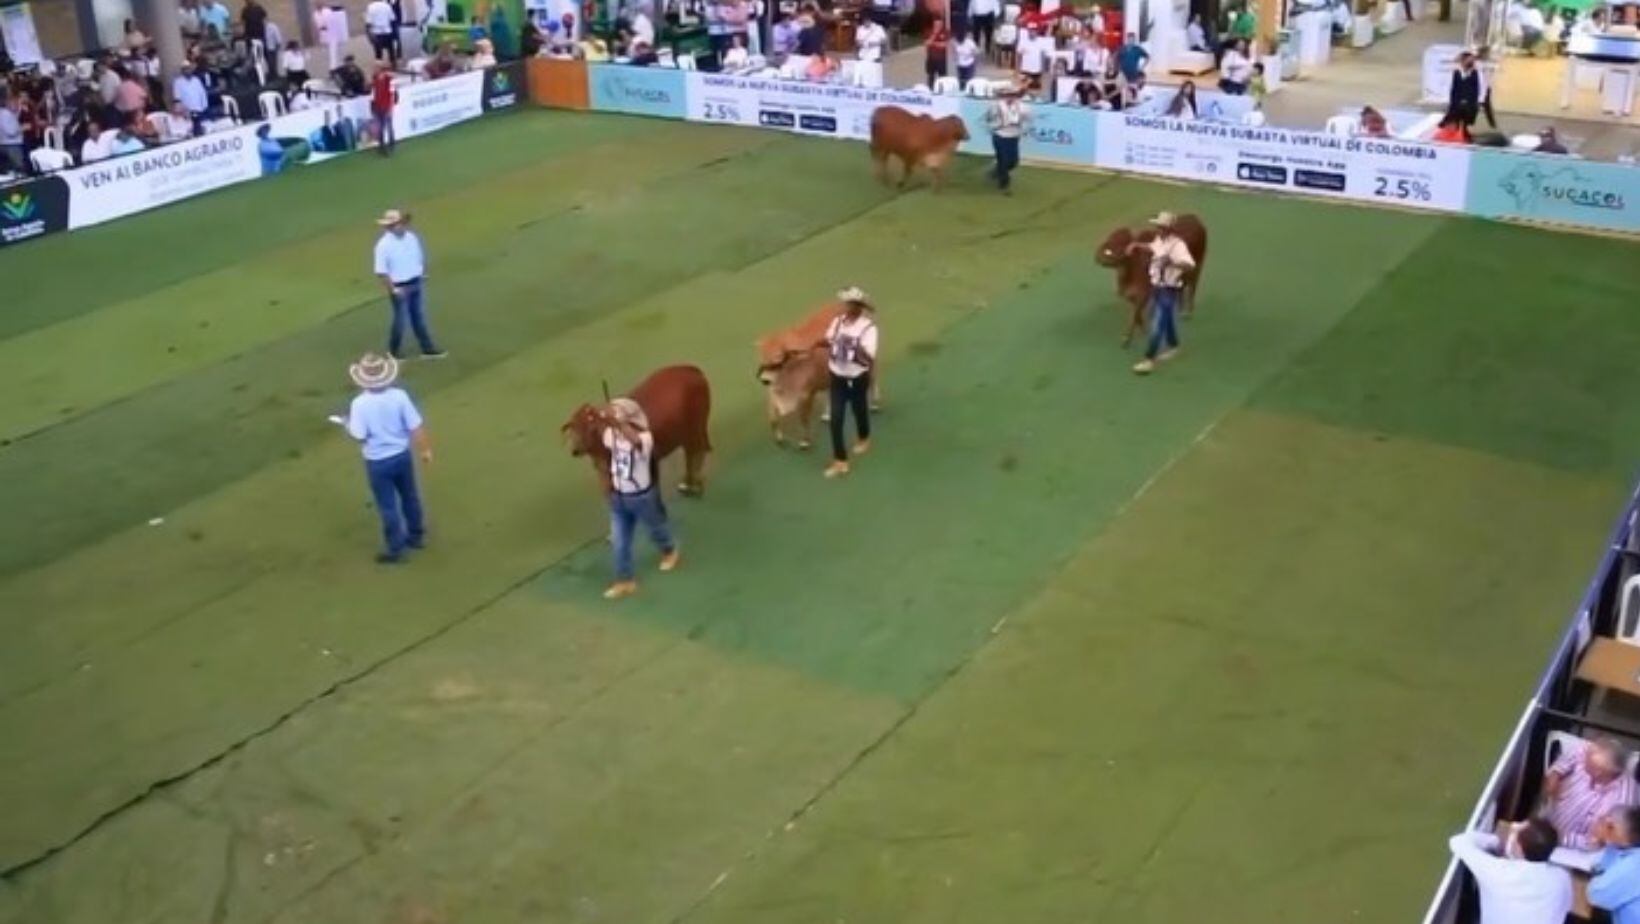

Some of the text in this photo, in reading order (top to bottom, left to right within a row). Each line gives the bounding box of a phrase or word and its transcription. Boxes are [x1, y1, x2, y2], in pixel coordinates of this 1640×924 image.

[703, 102, 742, 120] 2.5%
[1125, 117, 1437, 159] SOMOS LA NUEVA SUBASTA VIRTUAL DE COLOMBIA
[81, 170, 112, 188] VEN
[132, 152, 183, 178] BANCO
[184, 136, 244, 163] AGRARIO
[1375, 176, 1431, 201] 2.5%
[1543, 186, 1624, 207] SUCACOL
